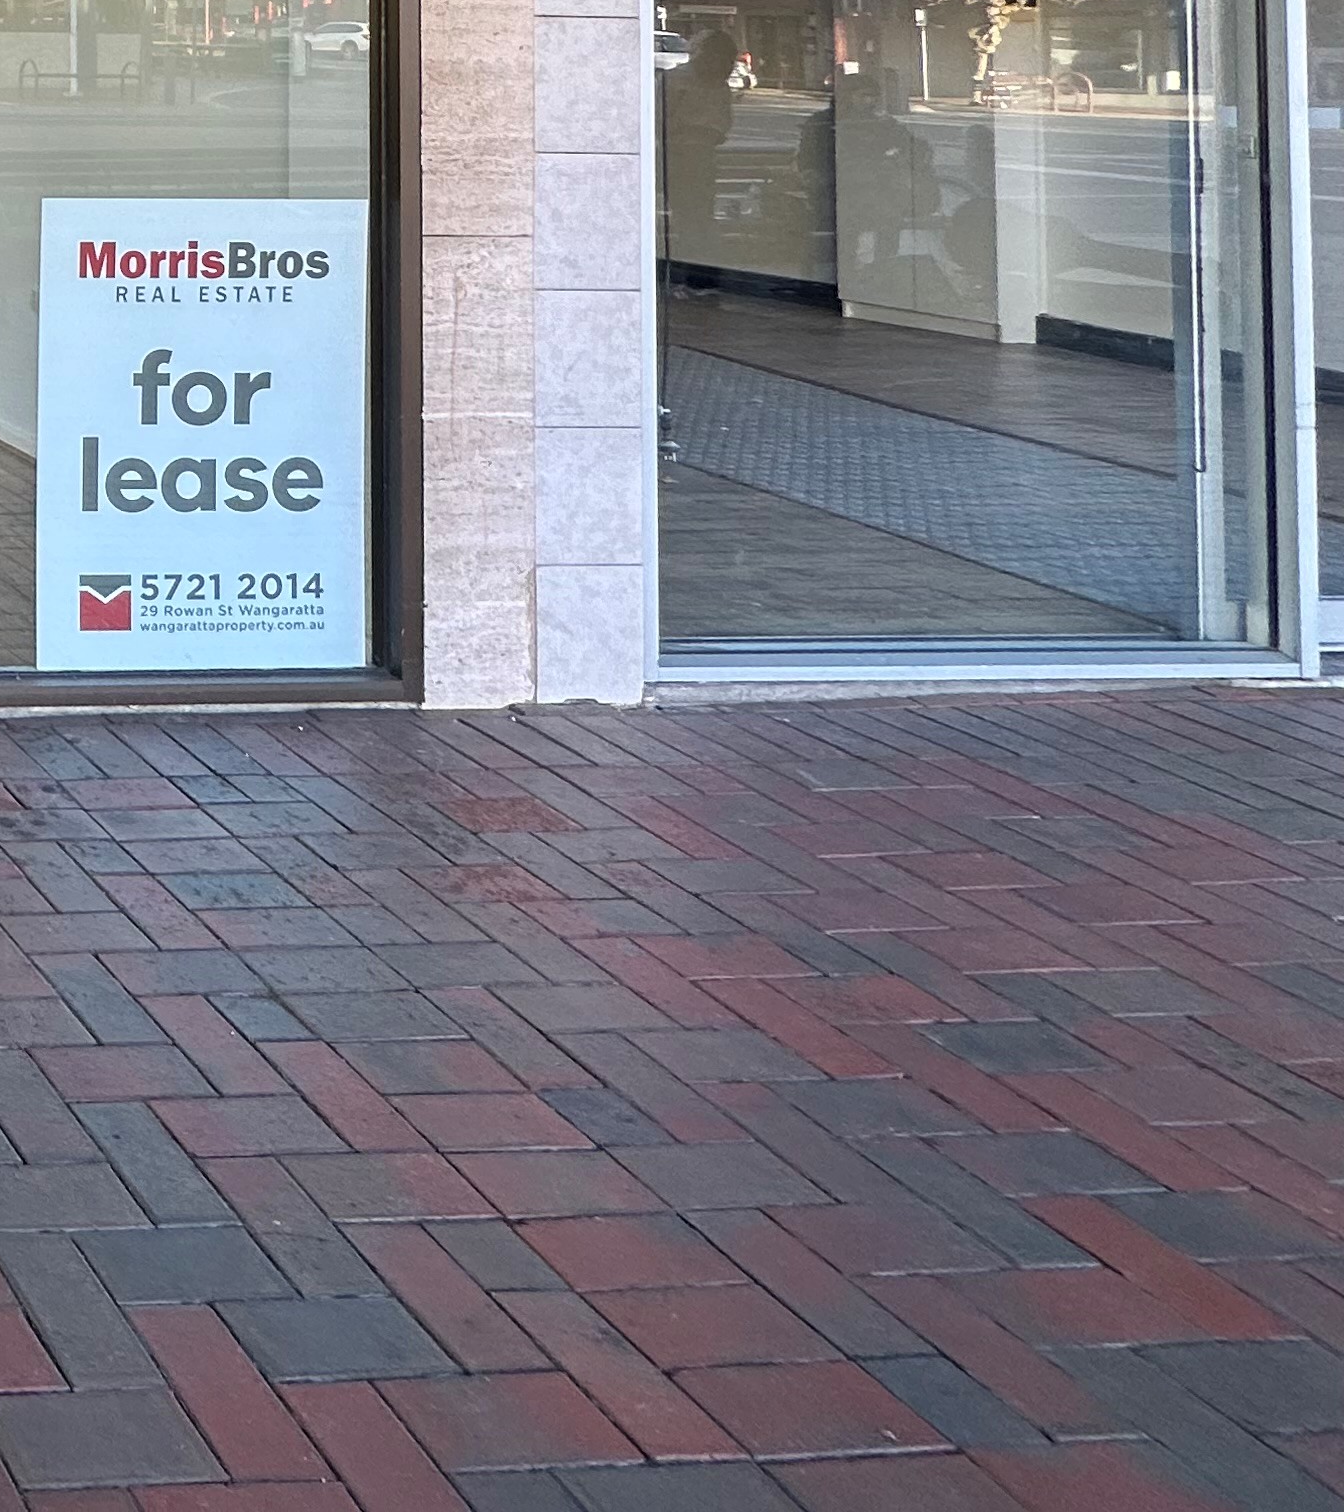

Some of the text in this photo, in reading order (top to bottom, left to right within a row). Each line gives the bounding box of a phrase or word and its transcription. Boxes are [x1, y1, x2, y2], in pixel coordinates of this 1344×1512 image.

[79, 241, 330, 279] MorrisBros
[116, 286, 293, 303] REAL ESTATE
[133, 349, 272, 426] for
[82, 437, 324, 513] lease
[140, 573, 324, 600] 5721 2014
[140, 604, 324, 618] 29 Rowan St Wangaratta
[140, 620, 325, 634] wangarattaproperty.com.au
